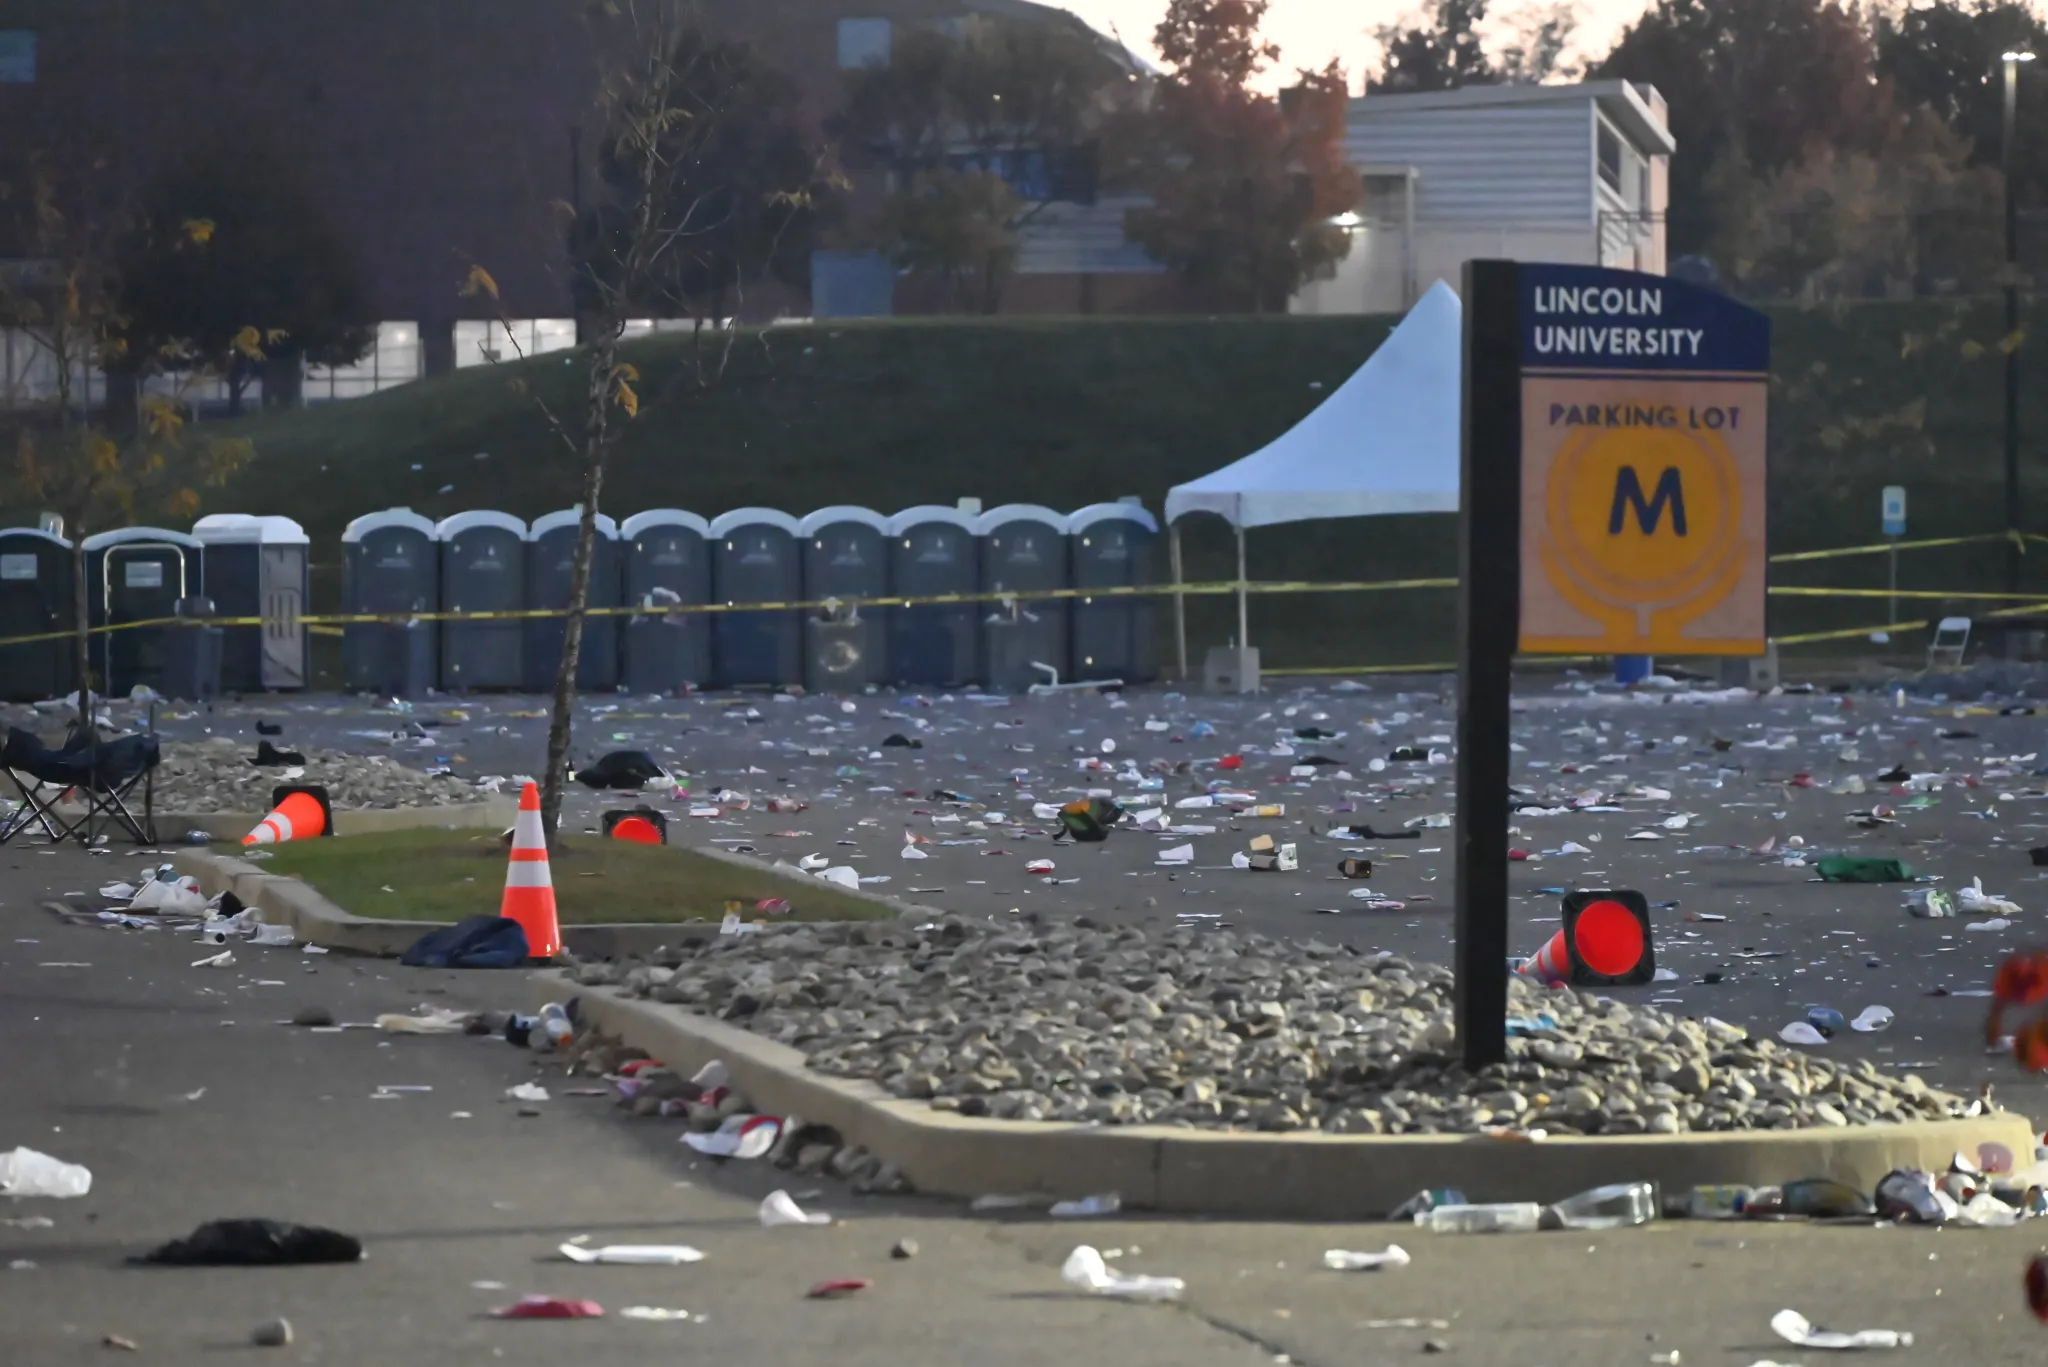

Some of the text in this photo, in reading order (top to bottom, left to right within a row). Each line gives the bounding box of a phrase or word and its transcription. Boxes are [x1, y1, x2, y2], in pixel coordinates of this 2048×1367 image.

[1534, 287, 1662, 315] LINCOLN
[1534, 326, 1704, 355] UNIVERSITY
[1549, 403, 1741, 430] PARKING LOT
[1608, 465, 1687, 537] M
